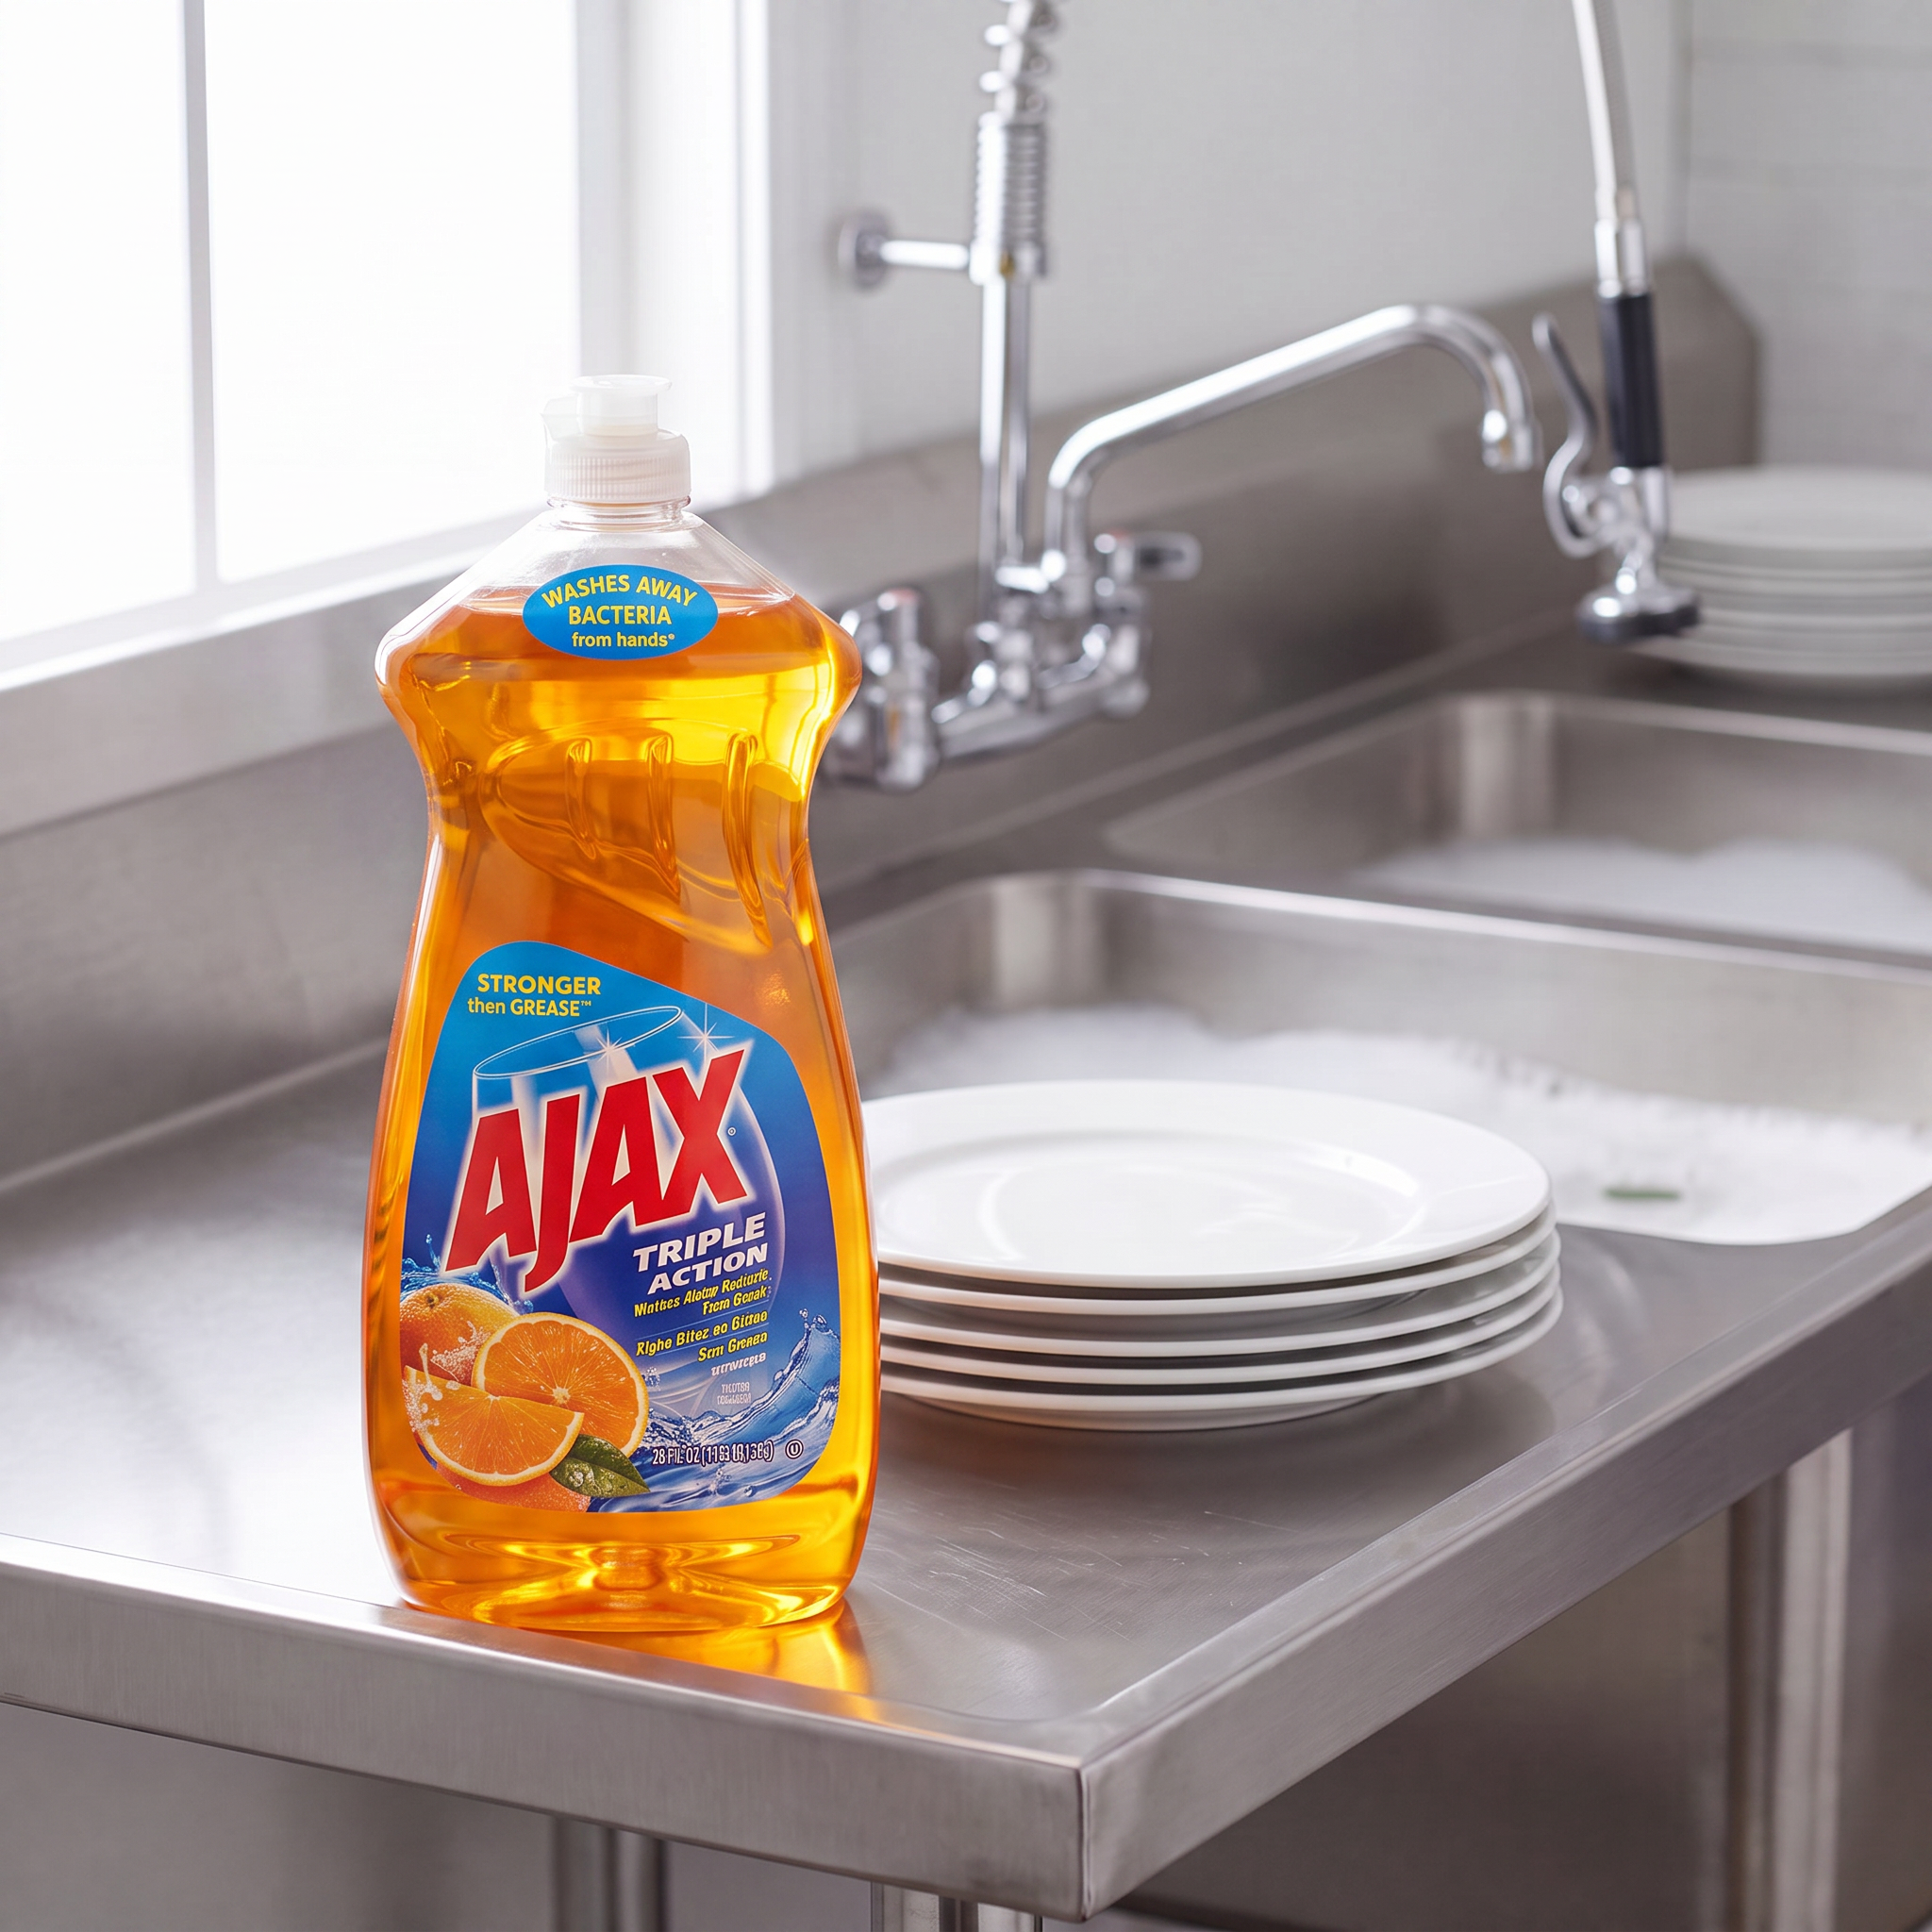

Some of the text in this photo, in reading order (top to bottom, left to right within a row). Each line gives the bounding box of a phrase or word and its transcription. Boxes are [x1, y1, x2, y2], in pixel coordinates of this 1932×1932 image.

[541, 575, 697, 608] WASHES AWAY
[569, 606, 672, 625] BACTERIA
[572, 632, 611, 647] from
[477, 974, 601, 994] STRONGER
[468, 997, 506, 1014] then
[445, 1049, 745, 1293] AJAX
[633, 1212, 766, 1273] TRIPLE
[647, 1242, 768, 1295] ACTION
[653, 1448, 666, 1464] 28
